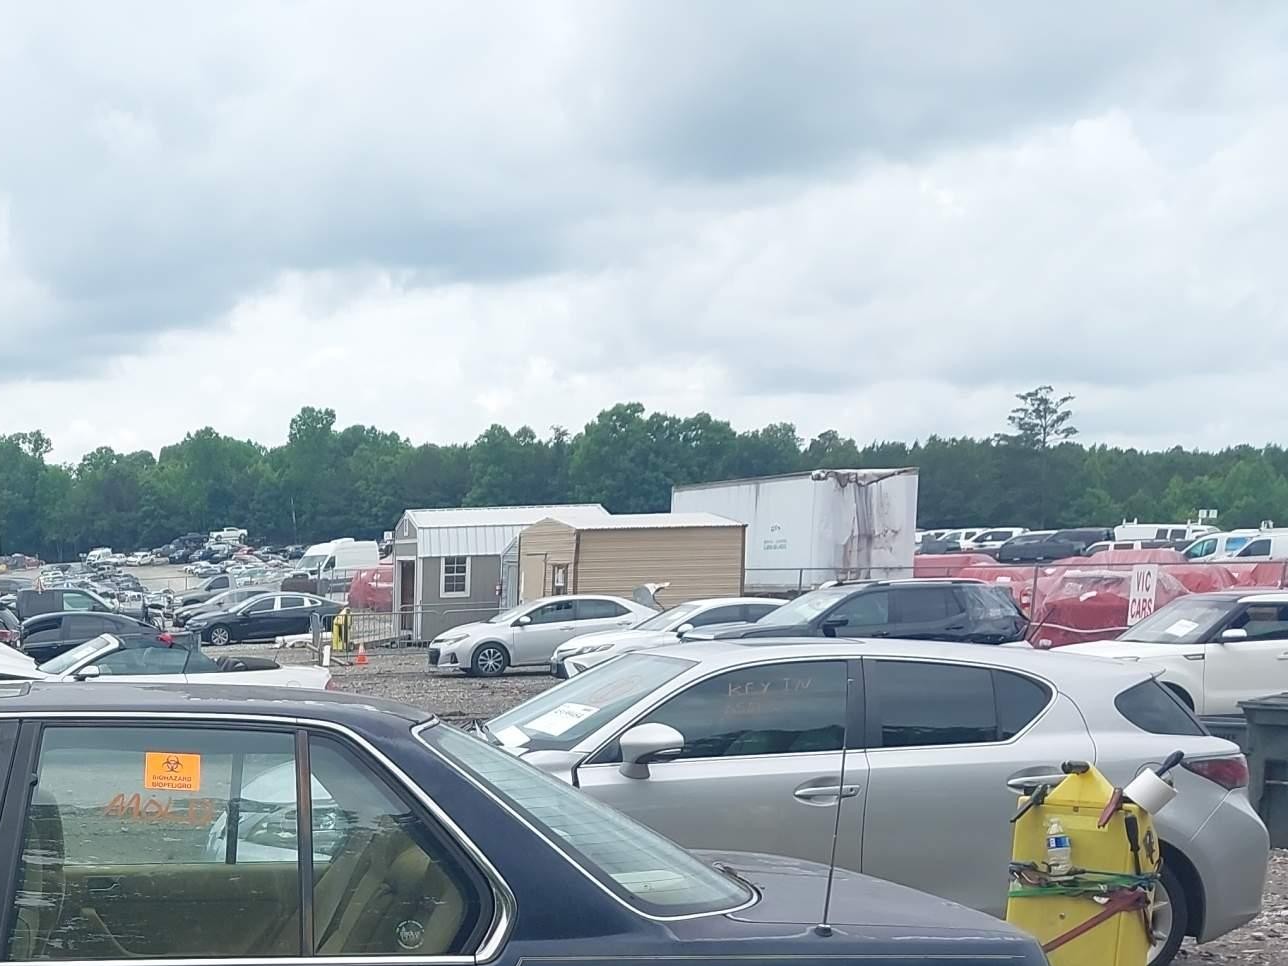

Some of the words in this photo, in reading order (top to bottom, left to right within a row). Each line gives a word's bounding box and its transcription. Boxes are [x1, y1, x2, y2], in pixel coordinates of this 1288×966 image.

[1136, 571, 1152, 592] VIC
[1130, 598, 1152, 618] CARS
[151, 781, 192, 789] BIOPELIGRO
